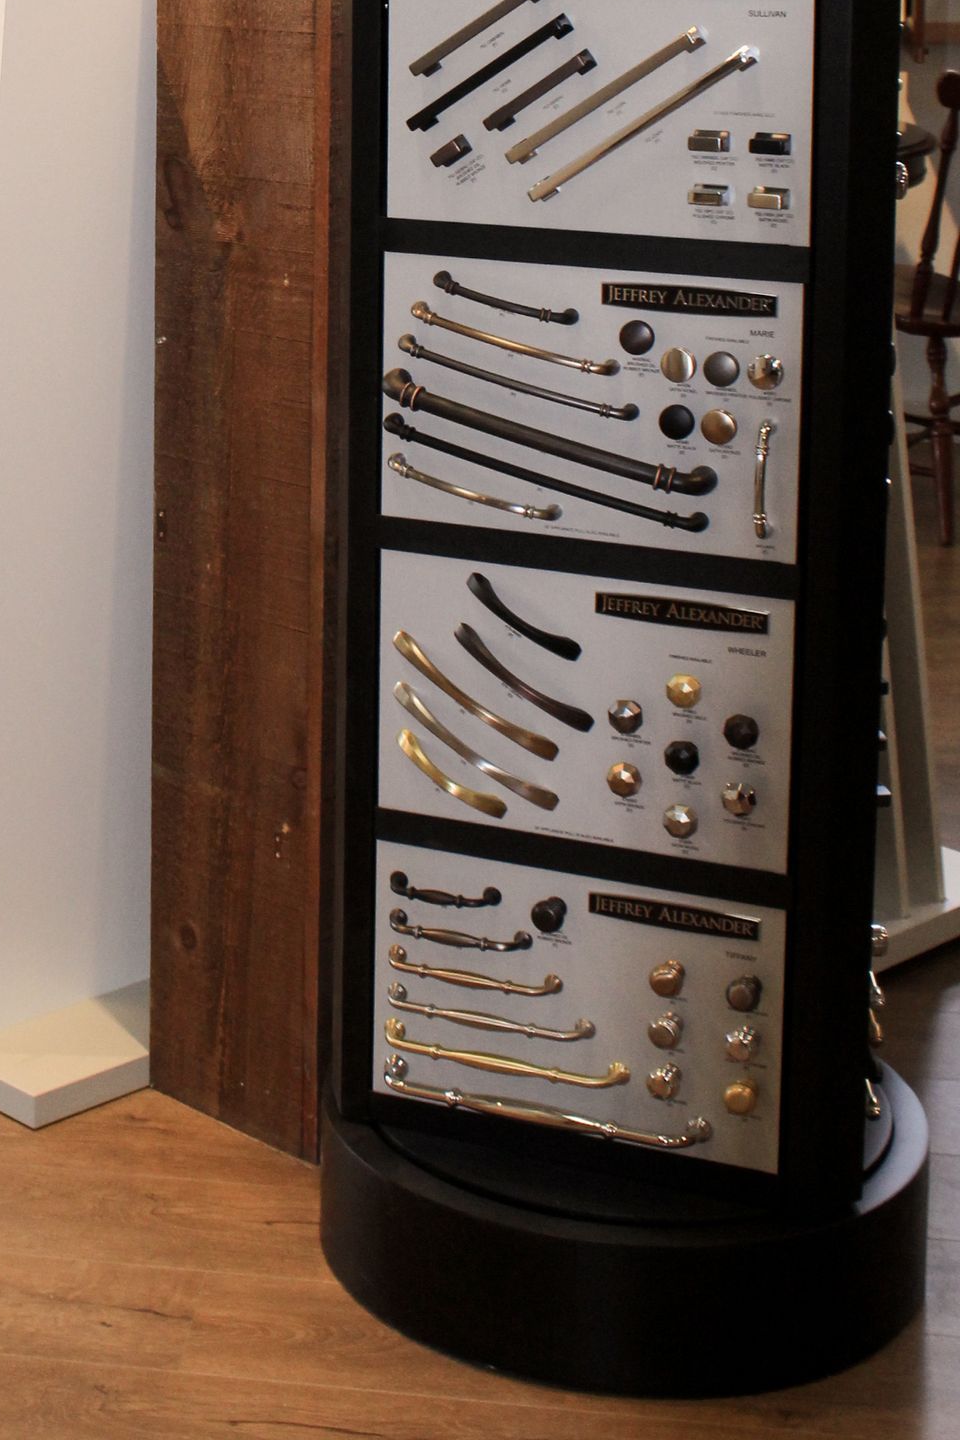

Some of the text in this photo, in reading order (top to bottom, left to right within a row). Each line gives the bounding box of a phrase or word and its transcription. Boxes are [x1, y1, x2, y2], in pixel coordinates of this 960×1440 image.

[748, 9, 787, 18] SULLIVAN
[608, 285, 669, 304] JEFFREY
[750, 329, 775, 339] MARIE
[601, 593, 661, 616] JEFFREY
[727, 646, 767, 658] WHEELER
[595, 895, 654, 919] JEFFREY
